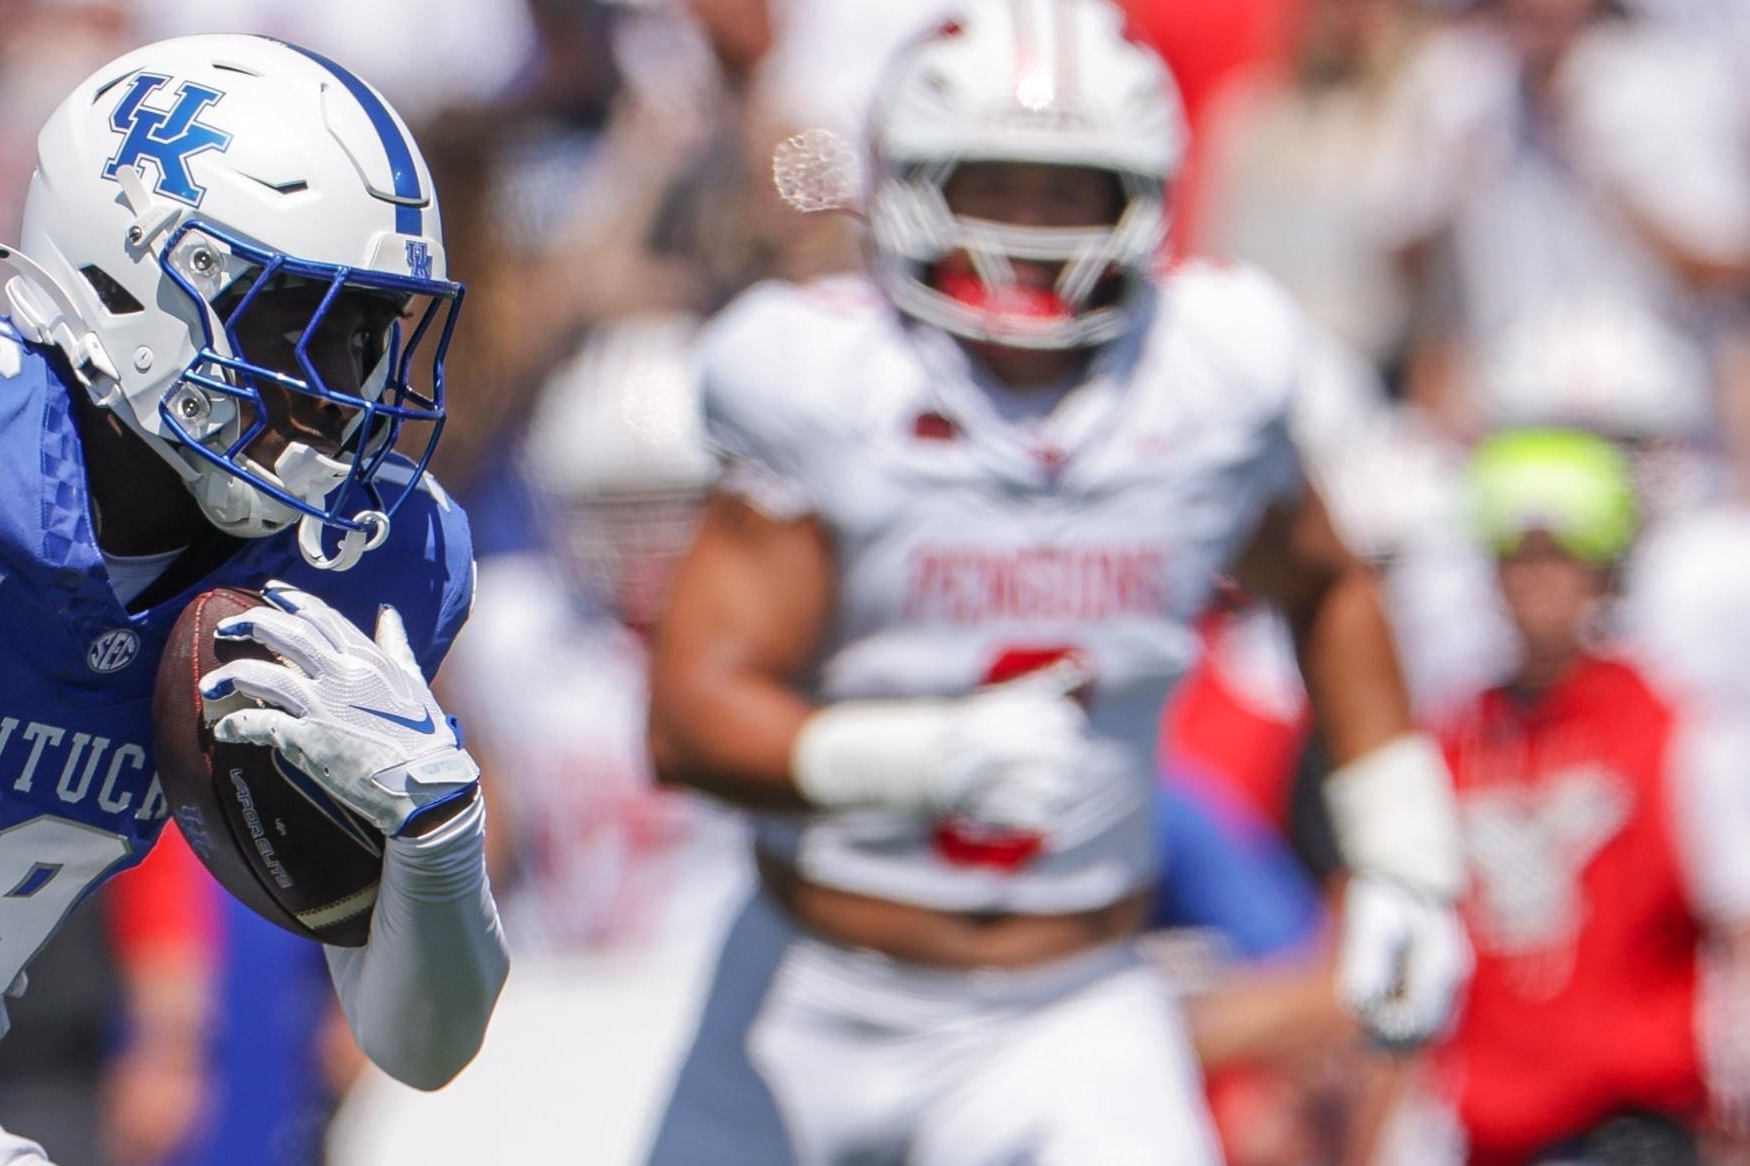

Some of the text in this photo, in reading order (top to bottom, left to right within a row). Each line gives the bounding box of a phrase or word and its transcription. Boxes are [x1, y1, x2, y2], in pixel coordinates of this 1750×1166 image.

[101, 71, 234, 209] UK
[88, 629, 138, 673] SEC
[229, 767, 294, 889] VAPOR ELITE
